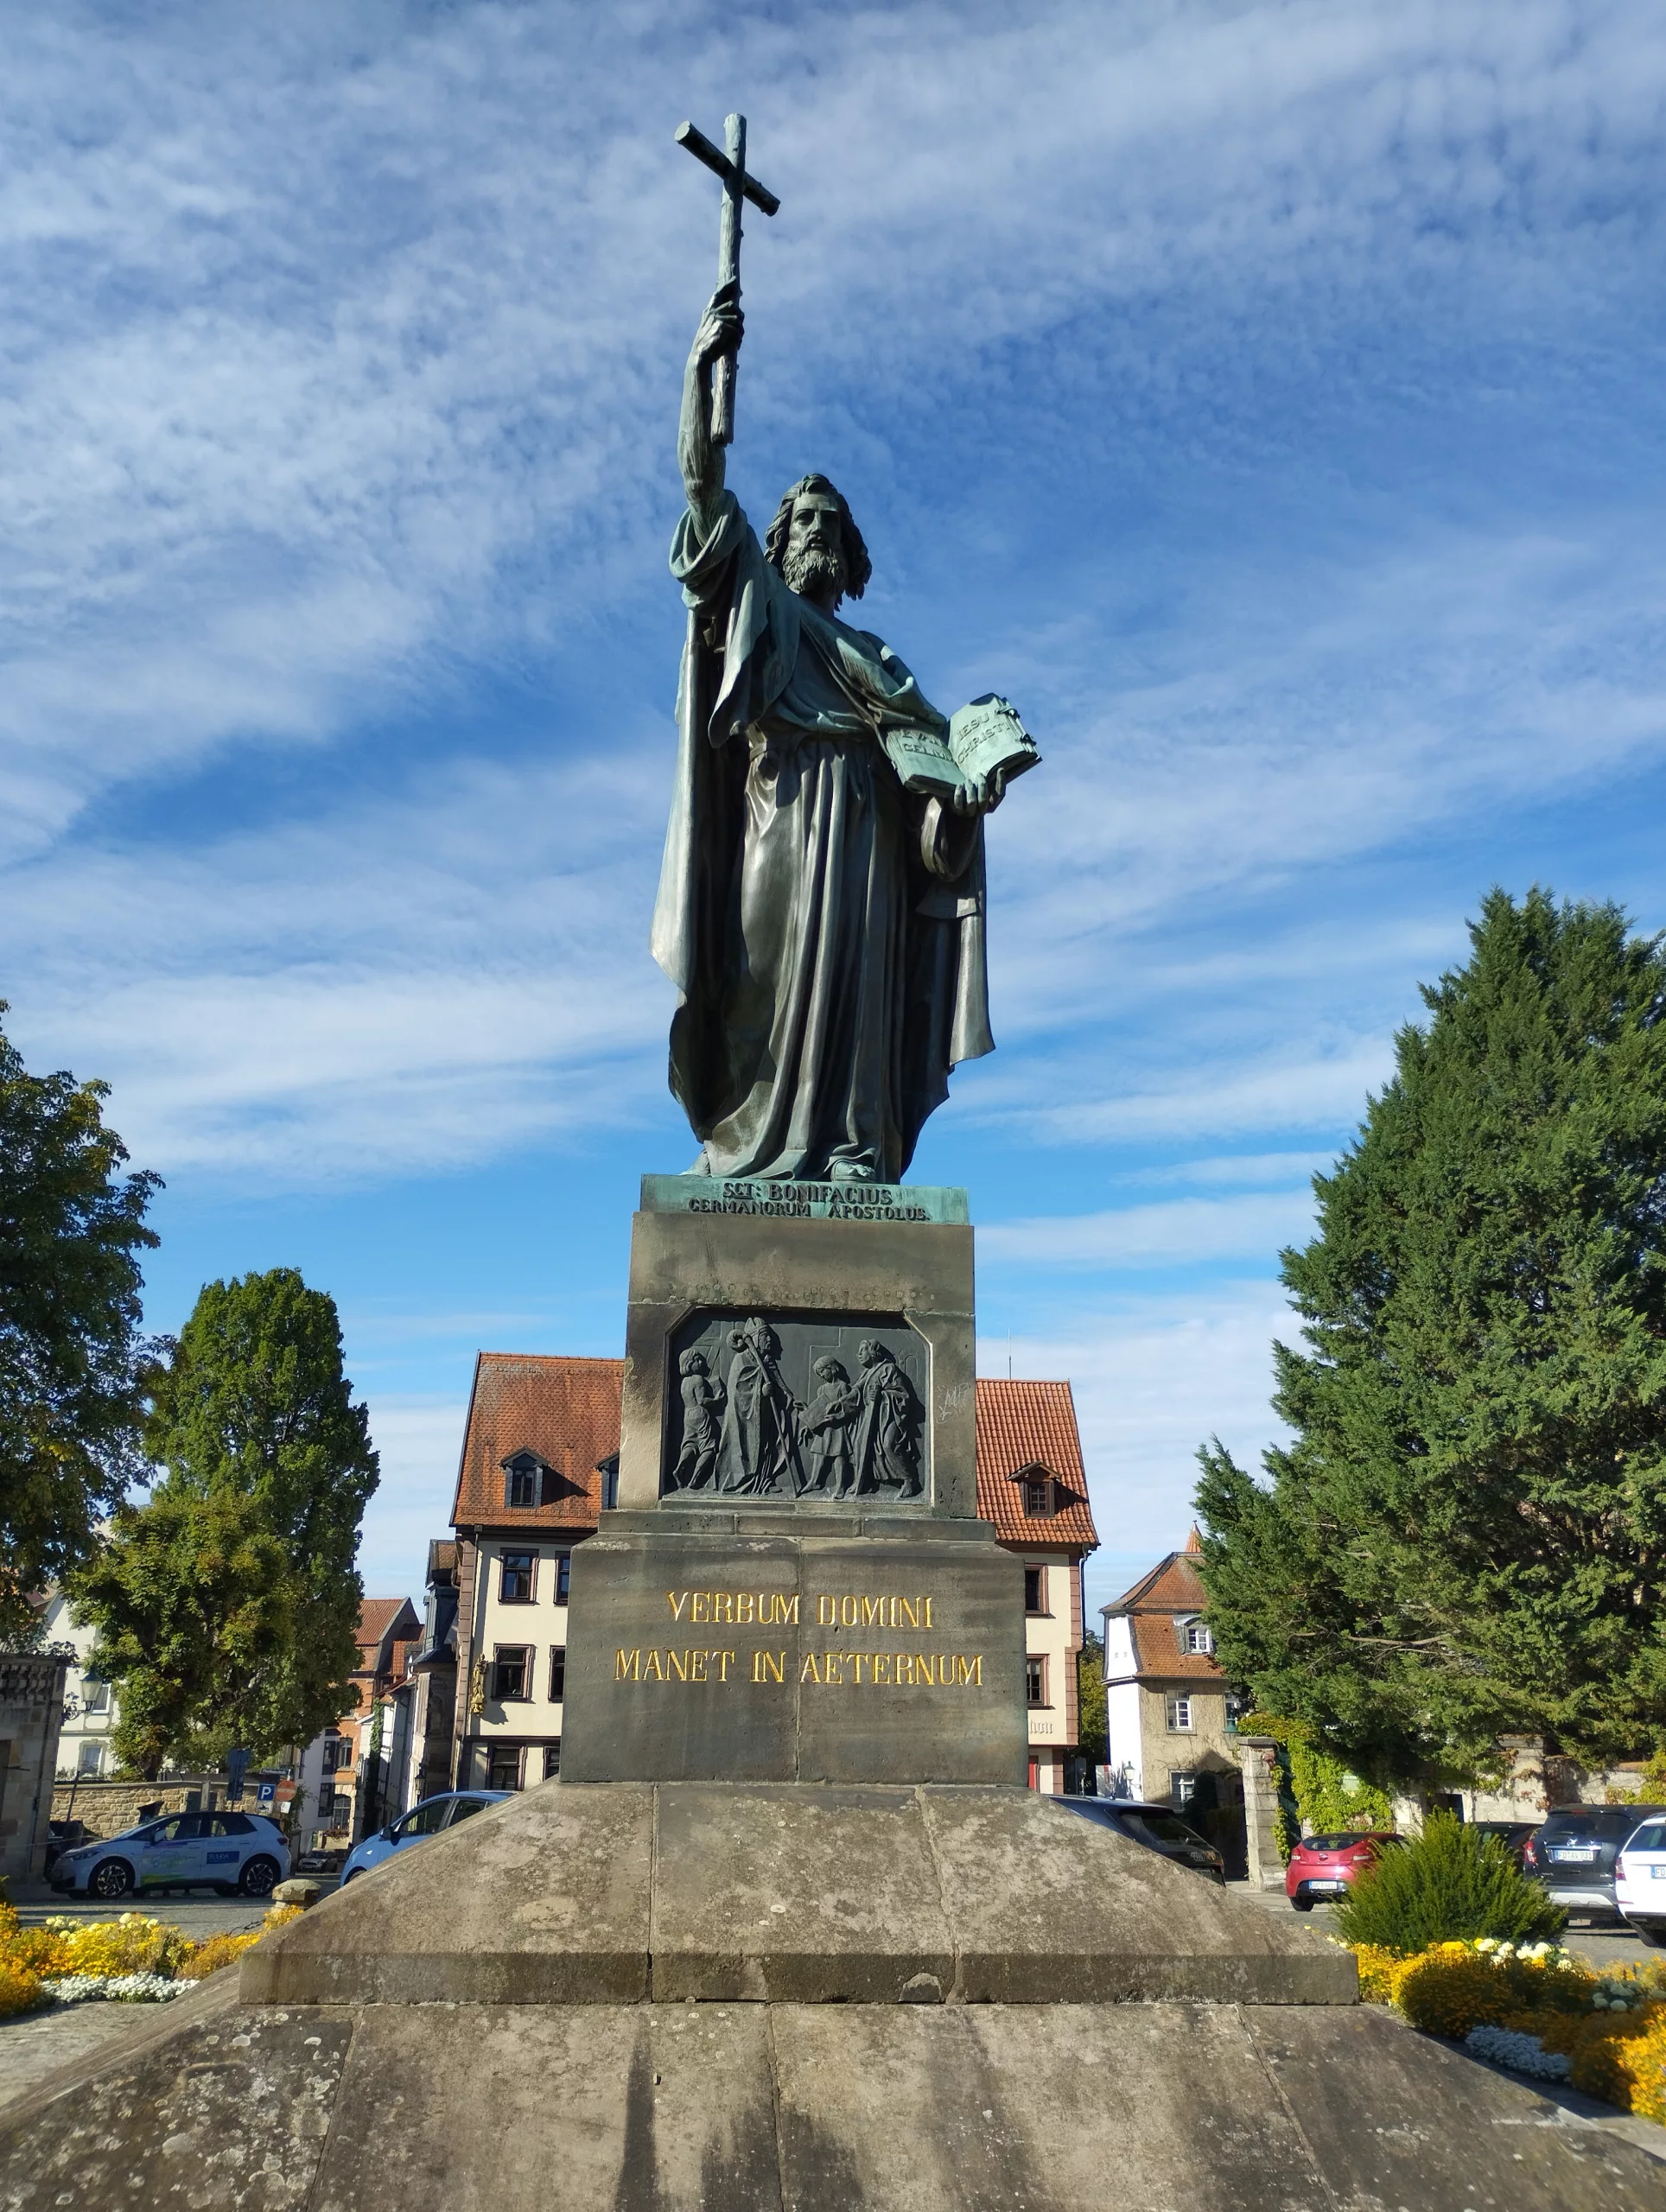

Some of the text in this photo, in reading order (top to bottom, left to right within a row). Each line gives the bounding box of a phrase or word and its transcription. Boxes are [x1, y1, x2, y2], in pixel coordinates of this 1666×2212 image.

[768, 1184, 893, 1205] BONIFACIUS
[664, 1591, 933, 1628] VERBUM DOMINI
[613, 1649, 983, 1686] MANET IN AETERNUM
[261, 1786, 272, 1800] P
